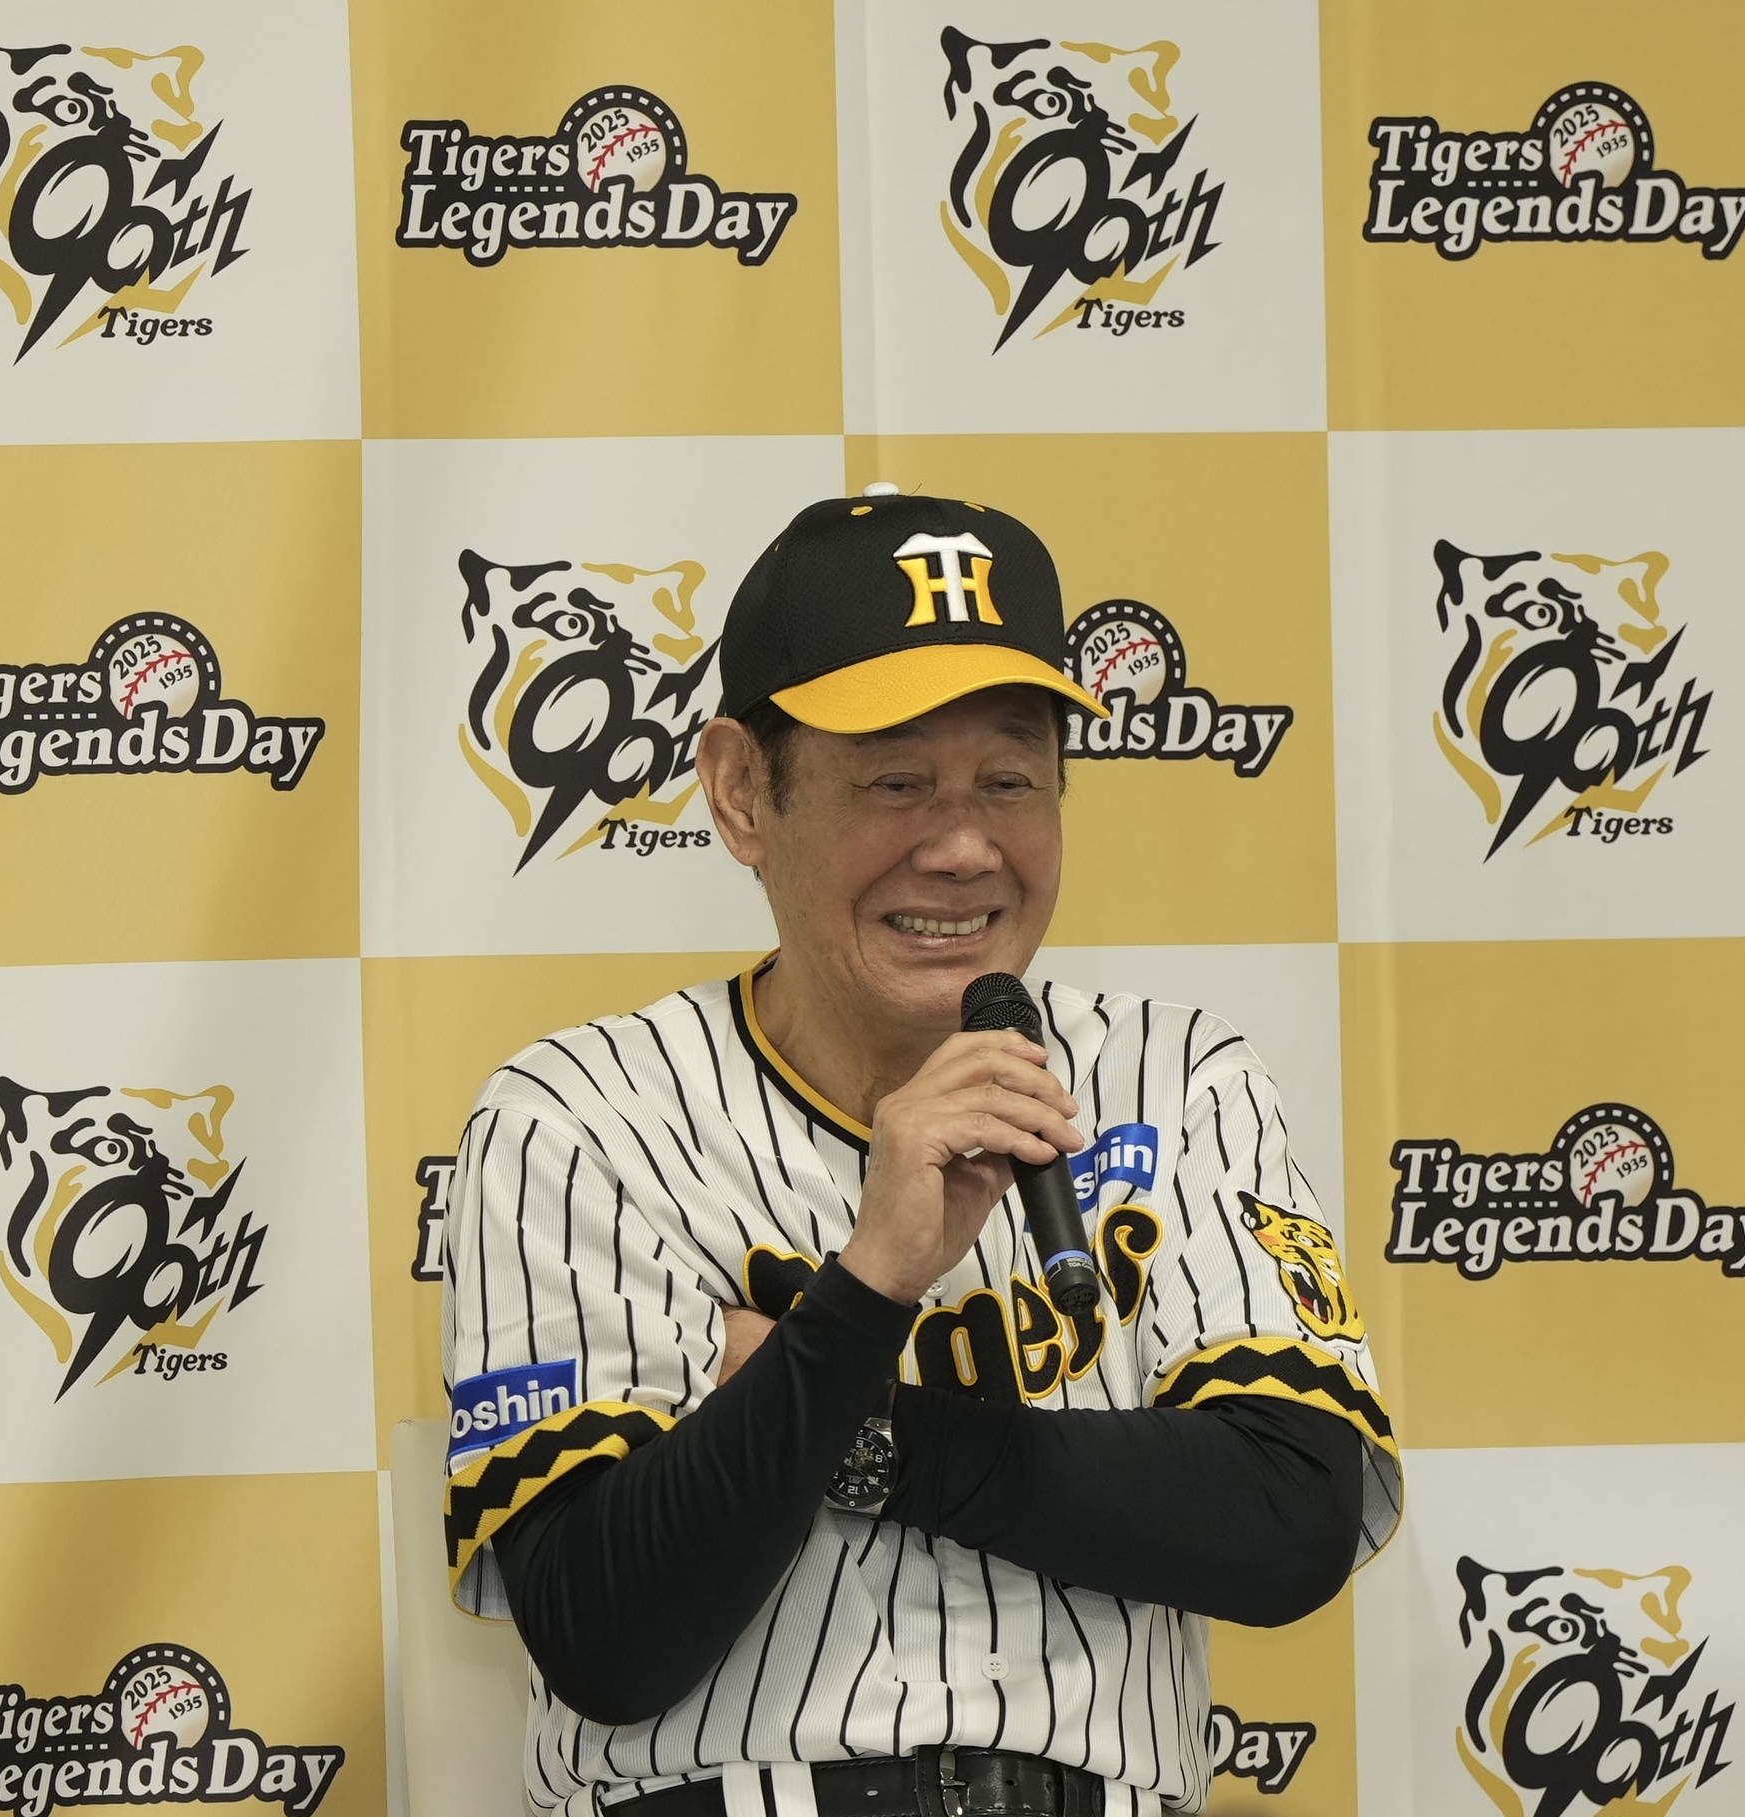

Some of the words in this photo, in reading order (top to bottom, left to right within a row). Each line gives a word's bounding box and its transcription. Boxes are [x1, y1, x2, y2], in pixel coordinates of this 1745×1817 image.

[581, 108, 630, 153] 2025
[1553, 104, 1601, 148] 2025
[1594, 133, 1630, 159] 1935
[394, 129, 571, 193] Tigers
[624, 138, 661, 164] 1935
[1374, 125, 1544, 186] Tigers
[97, 305, 213, 345] Tigers
[1073, 296, 1186, 336] Tigers
[113, 635, 163, 680] 2025
[1084, 622, 1132, 666] 2025
[1126, 651, 1161, 677] 1935
[157, 664, 194, 690] 1935
[596, 816, 713, 857] Tigers
[1563, 804, 1675, 844] Tigers
[1573, 1125, 1620, 1169] 2025
[1615, 1154, 1649, 1179] 1935
[1396, 1146, 1564, 1208] Tigers
[130, 1340, 229, 1381] Tigers
[451, 1379, 570, 1439] oshin
[123, 1666, 173, 1711] 2025
[167, 1694, 205, 1720] 1935
